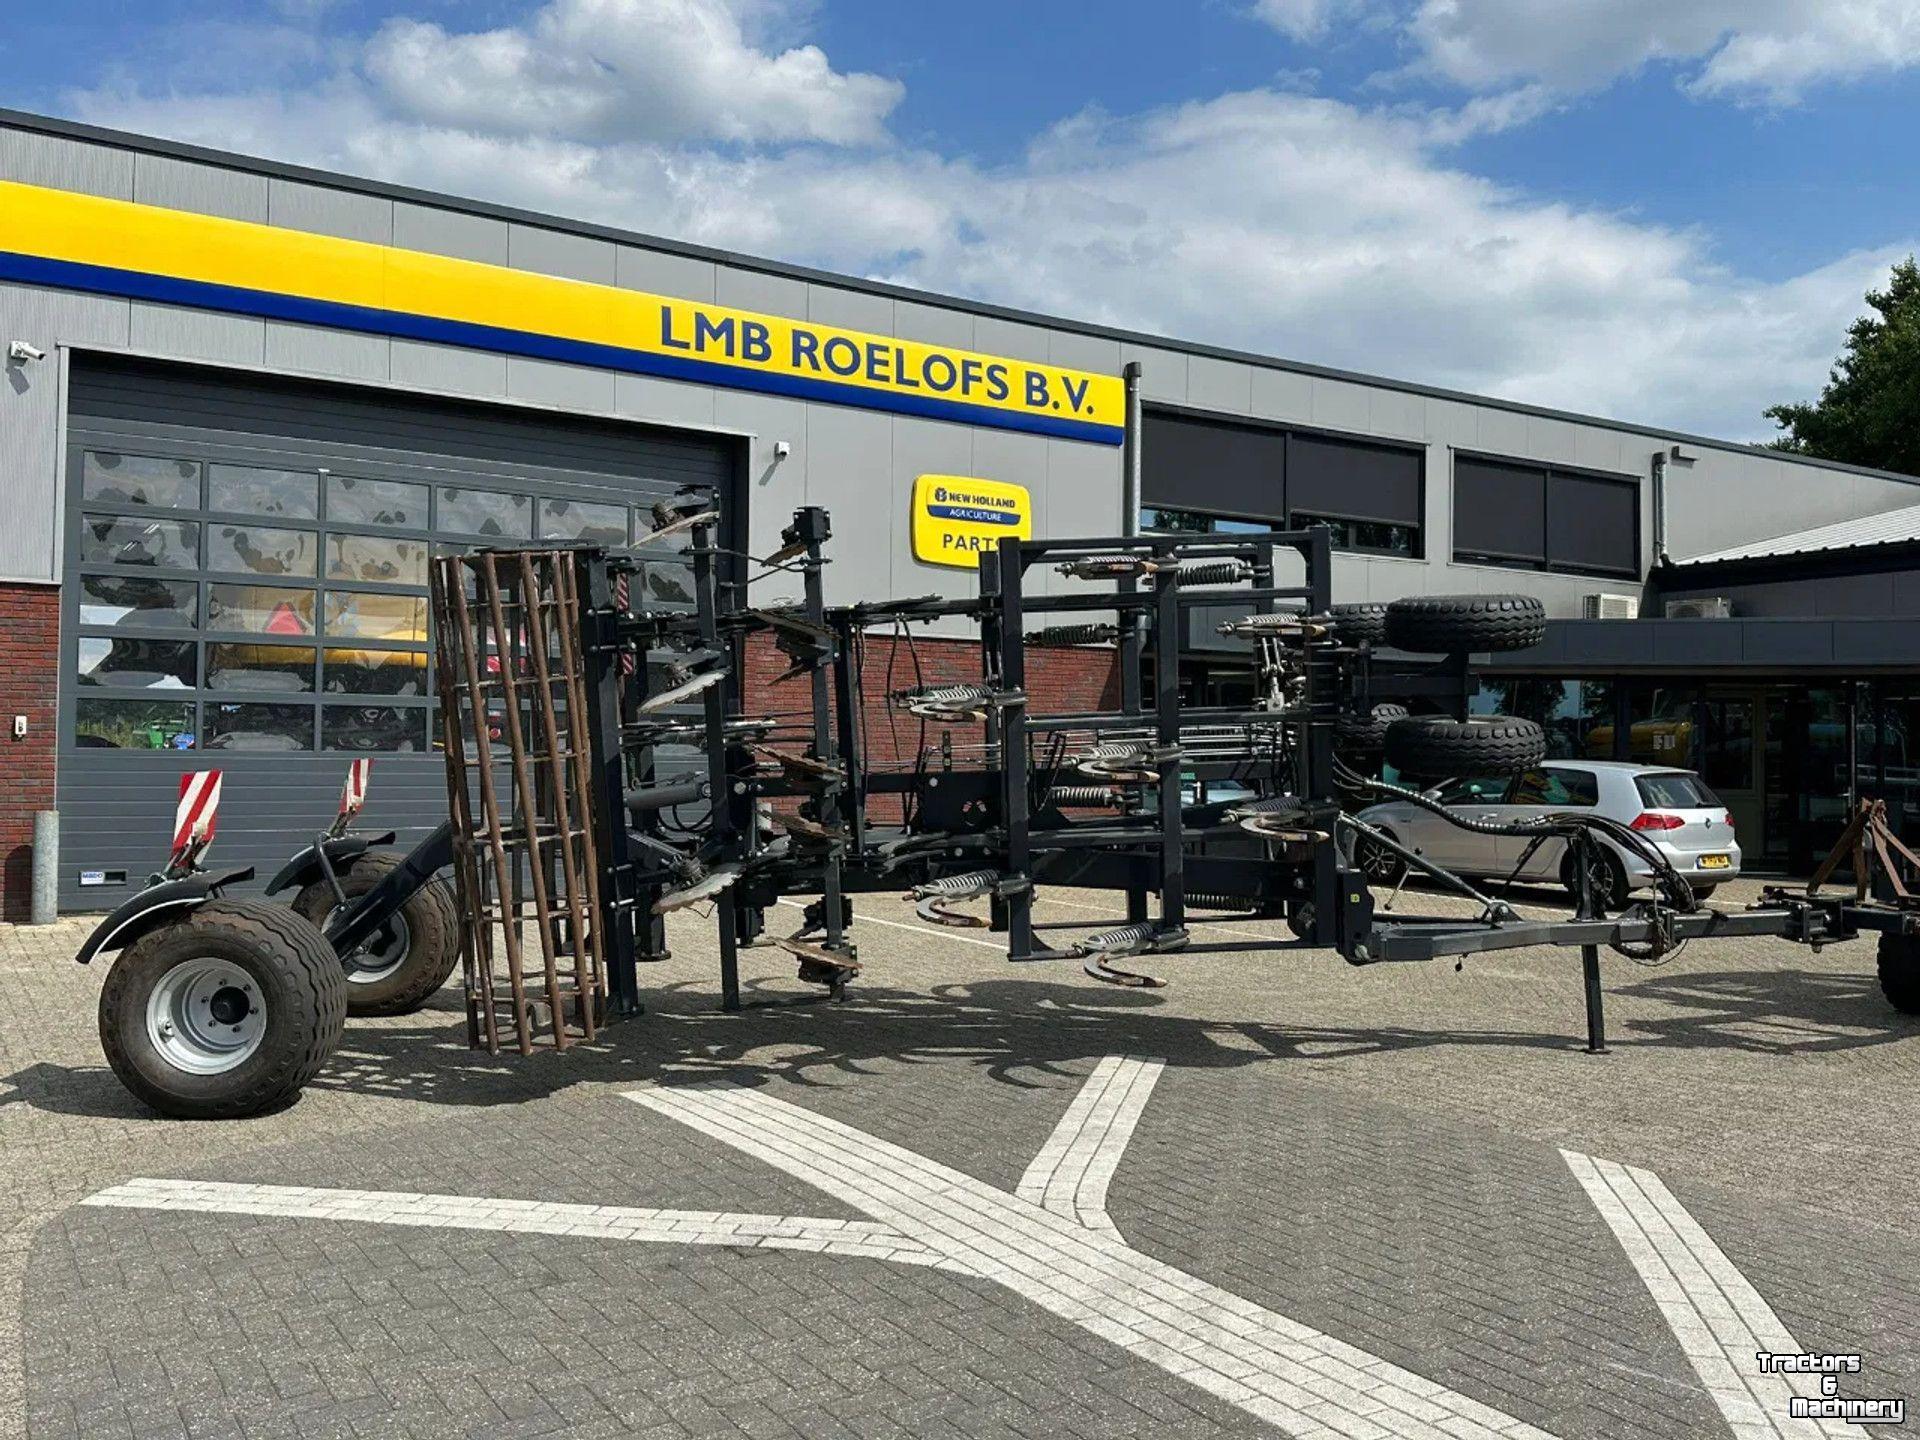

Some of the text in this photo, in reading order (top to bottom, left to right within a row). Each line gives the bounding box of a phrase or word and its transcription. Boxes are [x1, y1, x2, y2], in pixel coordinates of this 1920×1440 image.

[661, 305, 1094, 415] LMB ROELOFS B.V.
[949, 492, 1016, 508] NEW HOLLAND
[949, 508, 1002, 521] AGRICULTURE
